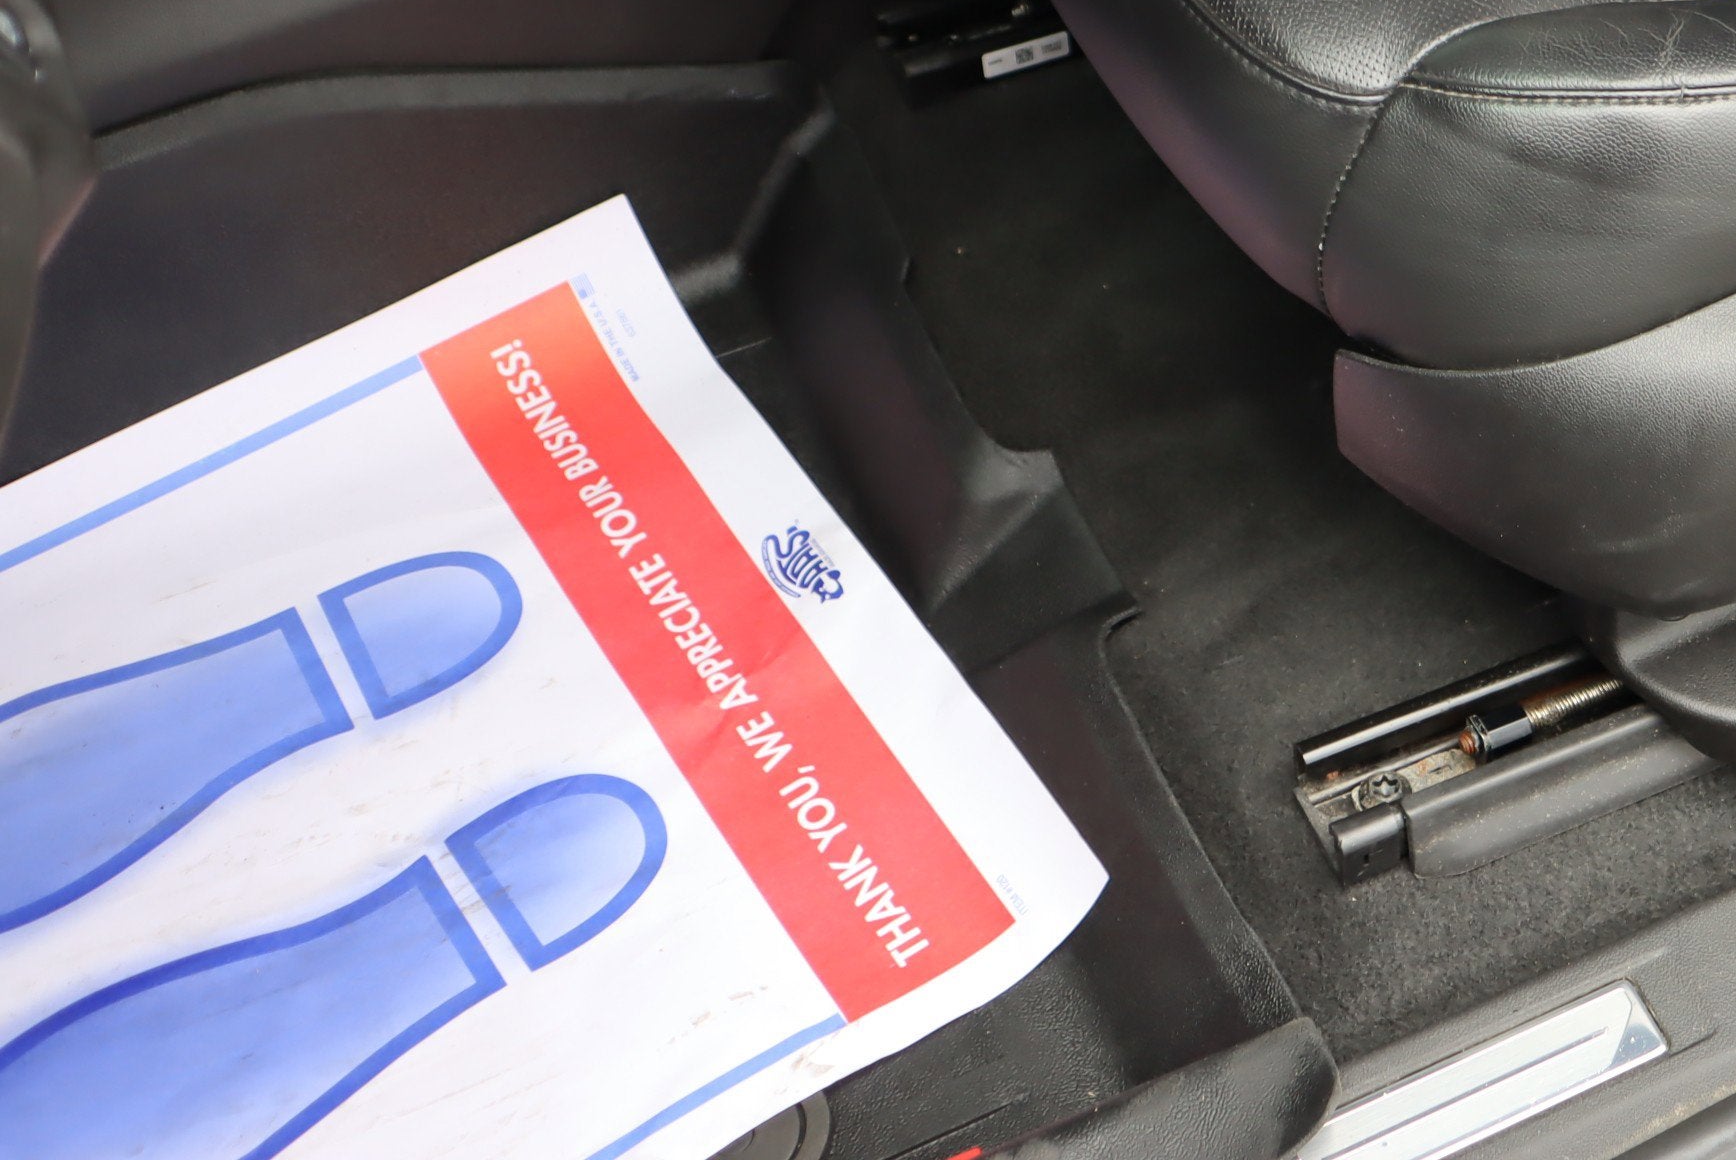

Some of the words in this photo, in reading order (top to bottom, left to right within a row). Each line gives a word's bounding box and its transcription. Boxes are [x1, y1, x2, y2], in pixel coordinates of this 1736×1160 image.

[603, 328, 618, 347] THE
[621, 358, 640, 381] MADE
[490, 338, 600, 481] BUSINESS!
[578, 475, 648, 559] YOUR
[628, 553, 759, 710] APPRECIATE
[735, 710, 793, 773] WE
[778, 765, 848, 854] YOU,
[828, 843, 930, 968] THANK
